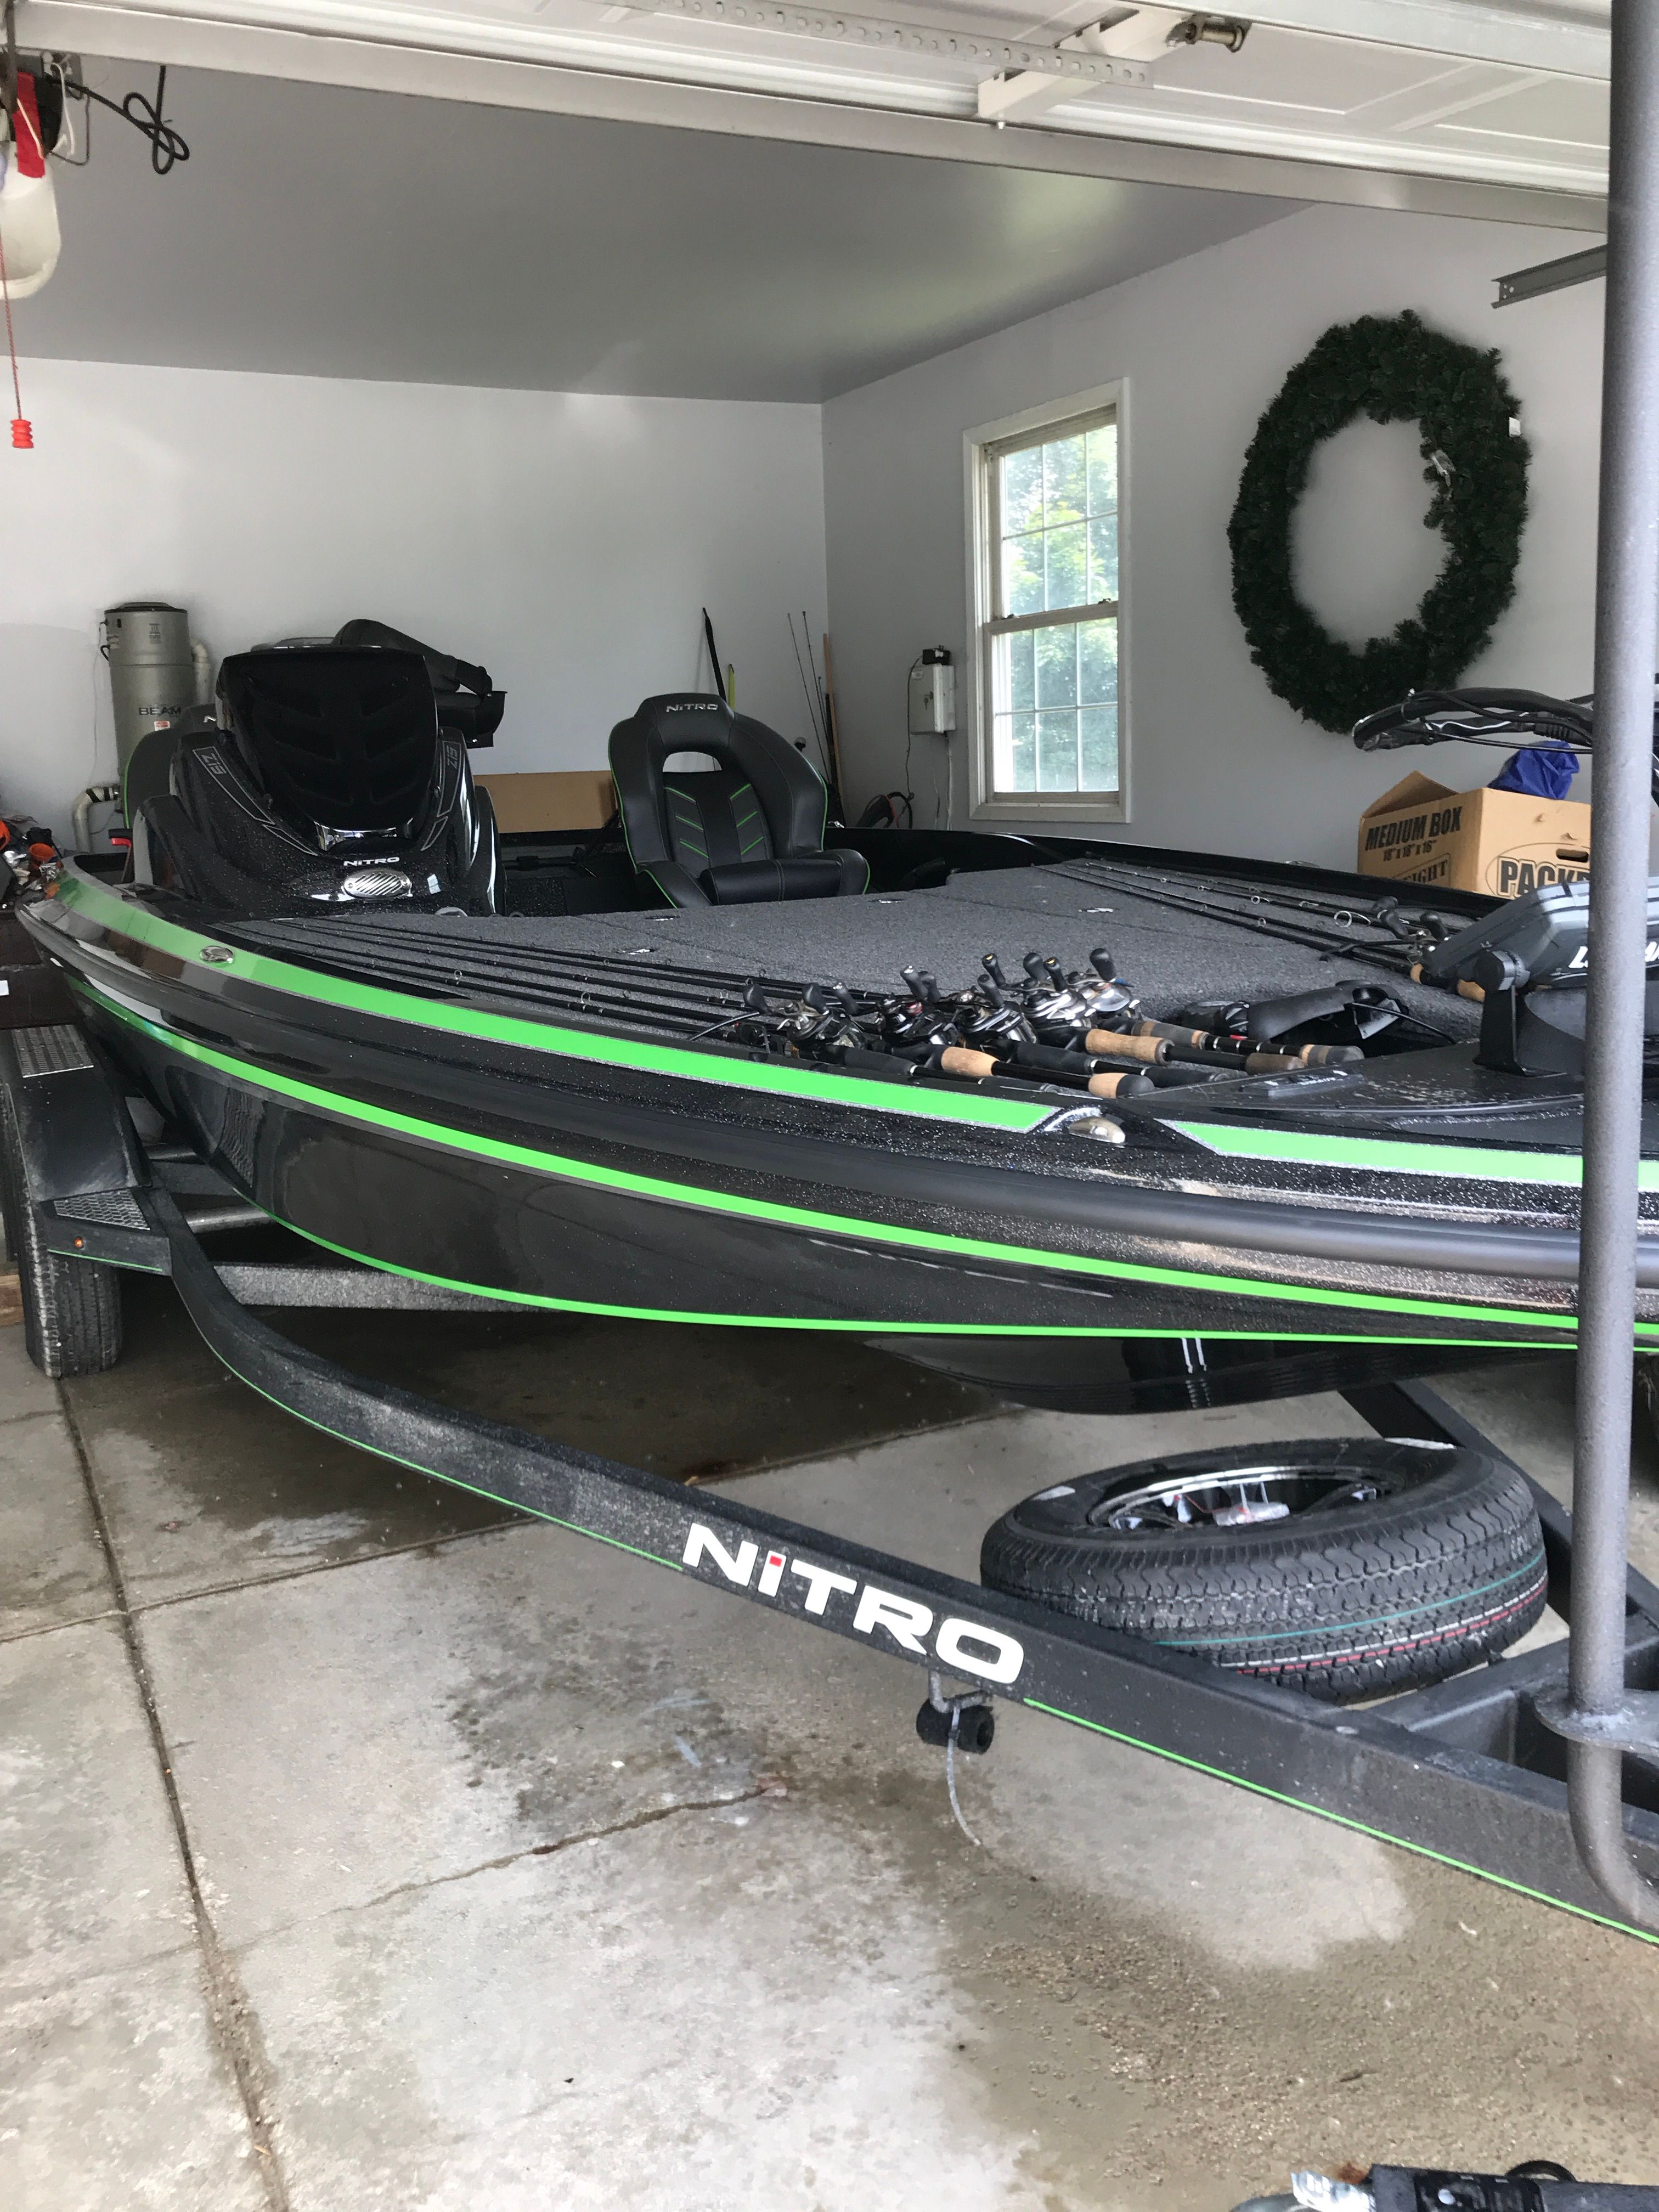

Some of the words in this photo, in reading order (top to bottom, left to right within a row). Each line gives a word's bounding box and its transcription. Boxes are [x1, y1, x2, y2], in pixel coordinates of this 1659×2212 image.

[138, 707, 182, 715] BEAM
[1365, 815, 1428, 851] MEDIUM
[1429, 806, 1463, 837] BOX
[343, 857, 400, 866] NITRO
